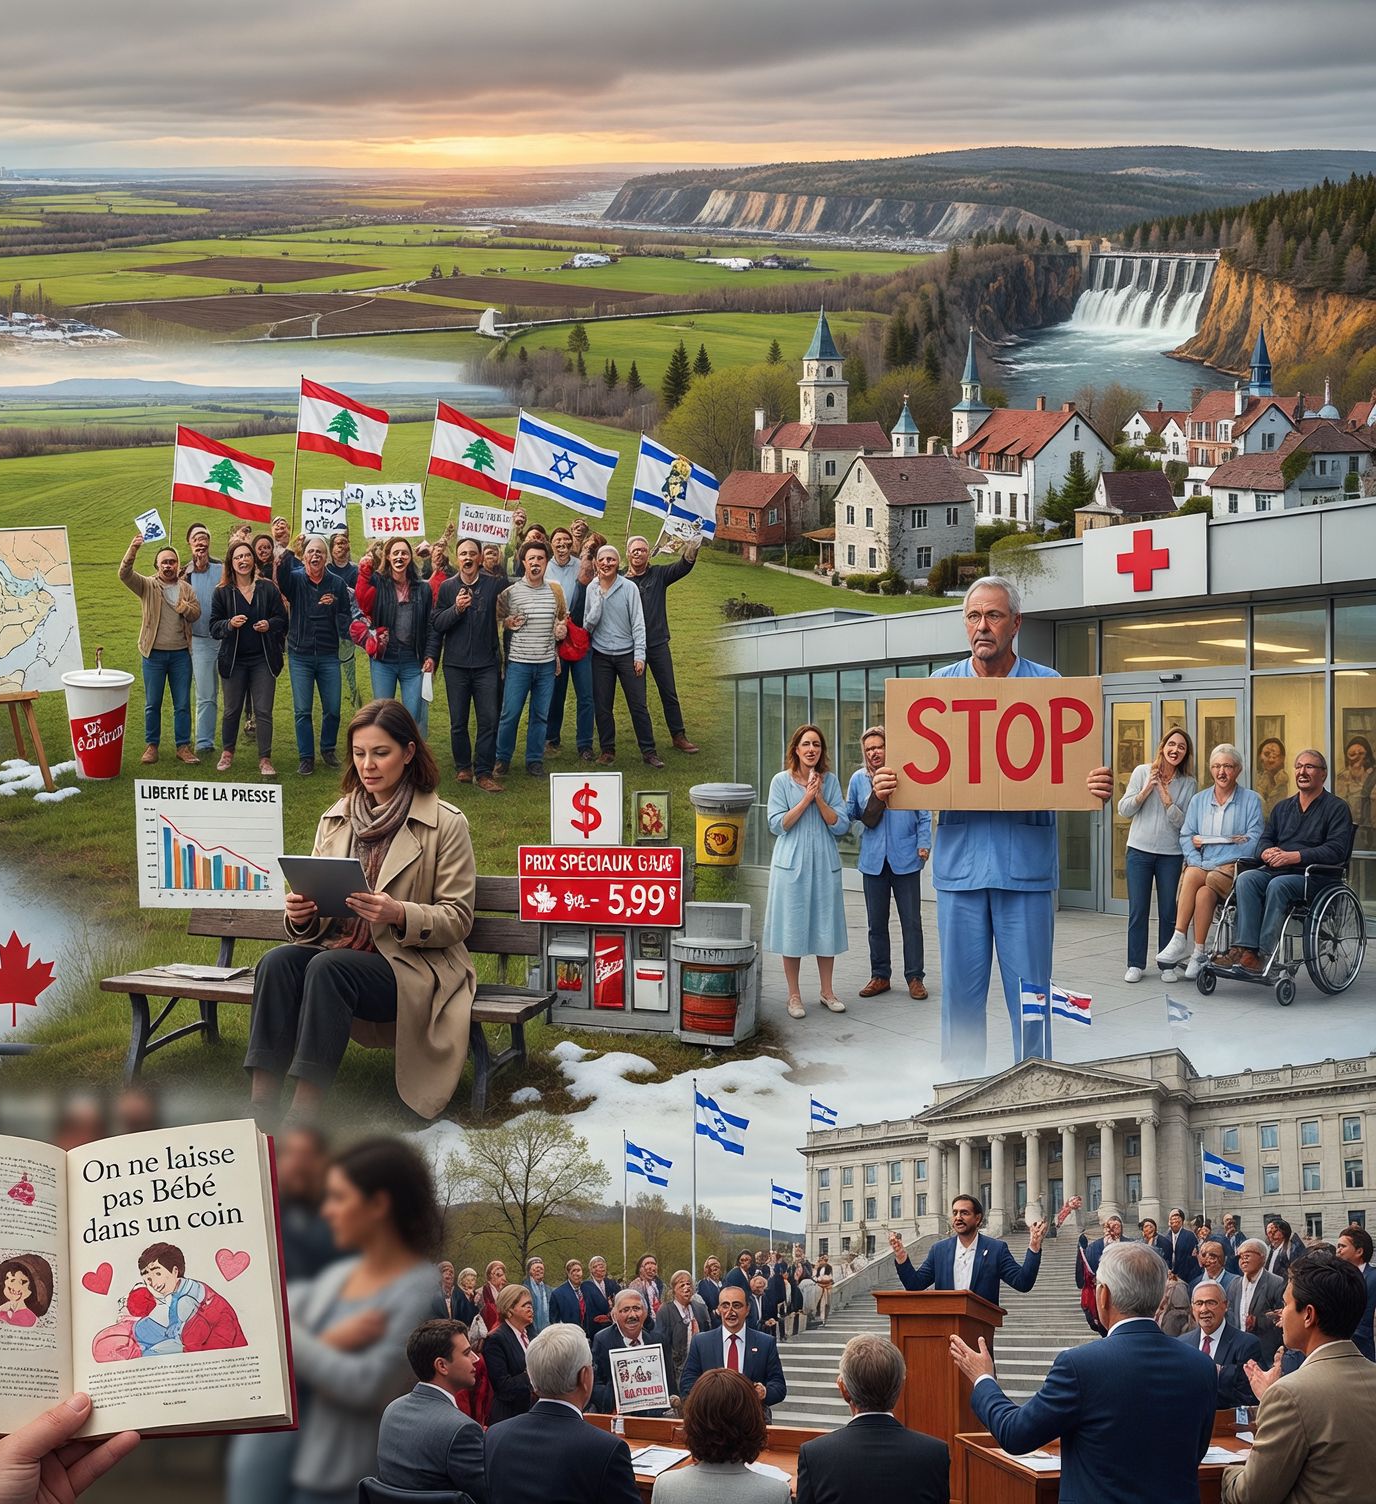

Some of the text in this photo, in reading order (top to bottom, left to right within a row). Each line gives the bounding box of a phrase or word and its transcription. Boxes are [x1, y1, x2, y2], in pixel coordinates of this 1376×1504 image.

[902, 697, 1094, 785] STOP
[140, 784, 276, 803] LIBERTÉ DE LA PRESSE
[525, 854, 556, 870] PRIX
[82, 1146, 236, 1183] On ne laisse
[102, 1172, 217, 1217] pas Bébé
[82, 1202, 244, 1244] dans un coin
